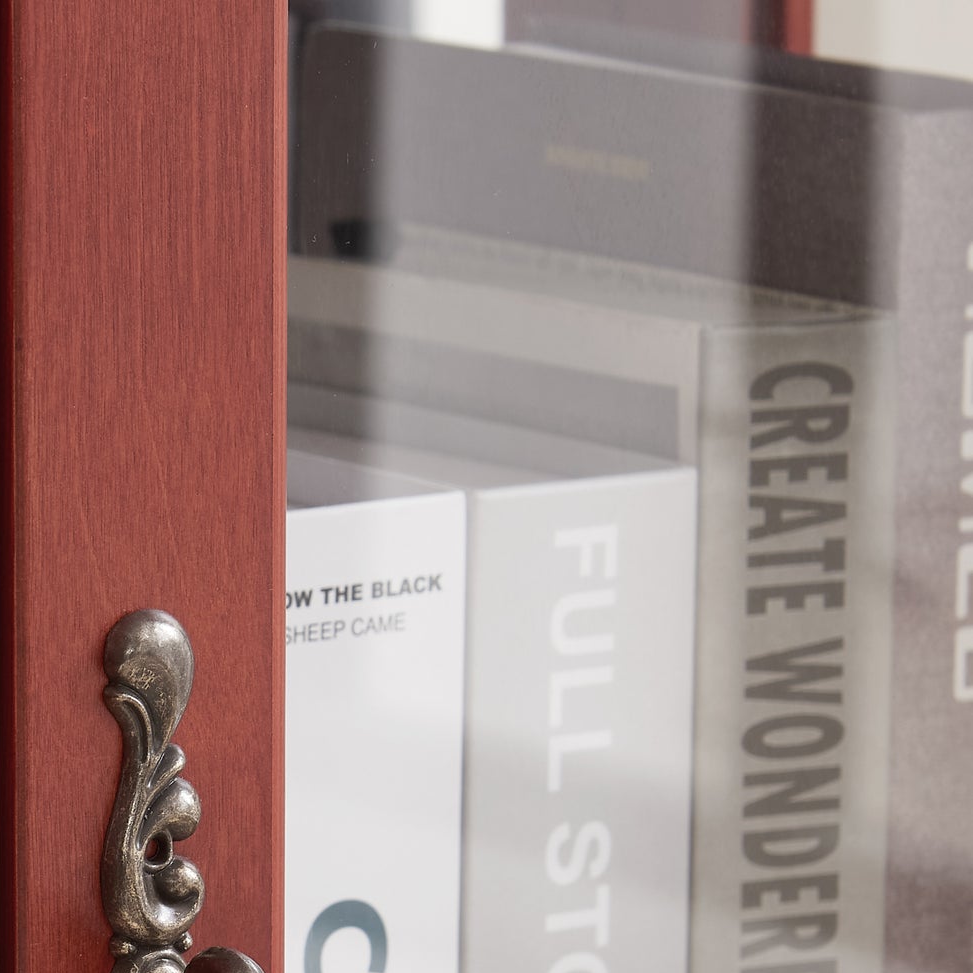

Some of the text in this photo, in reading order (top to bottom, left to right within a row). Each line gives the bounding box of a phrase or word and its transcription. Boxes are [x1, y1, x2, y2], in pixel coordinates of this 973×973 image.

[745, 361, 855, 616] CREATE
[321, 584, 363, 604] THE
[371, 573, 442, 599] BLACK
[350, 612, 406, 637] CAME
[547, 523, 619, 793] FULL
